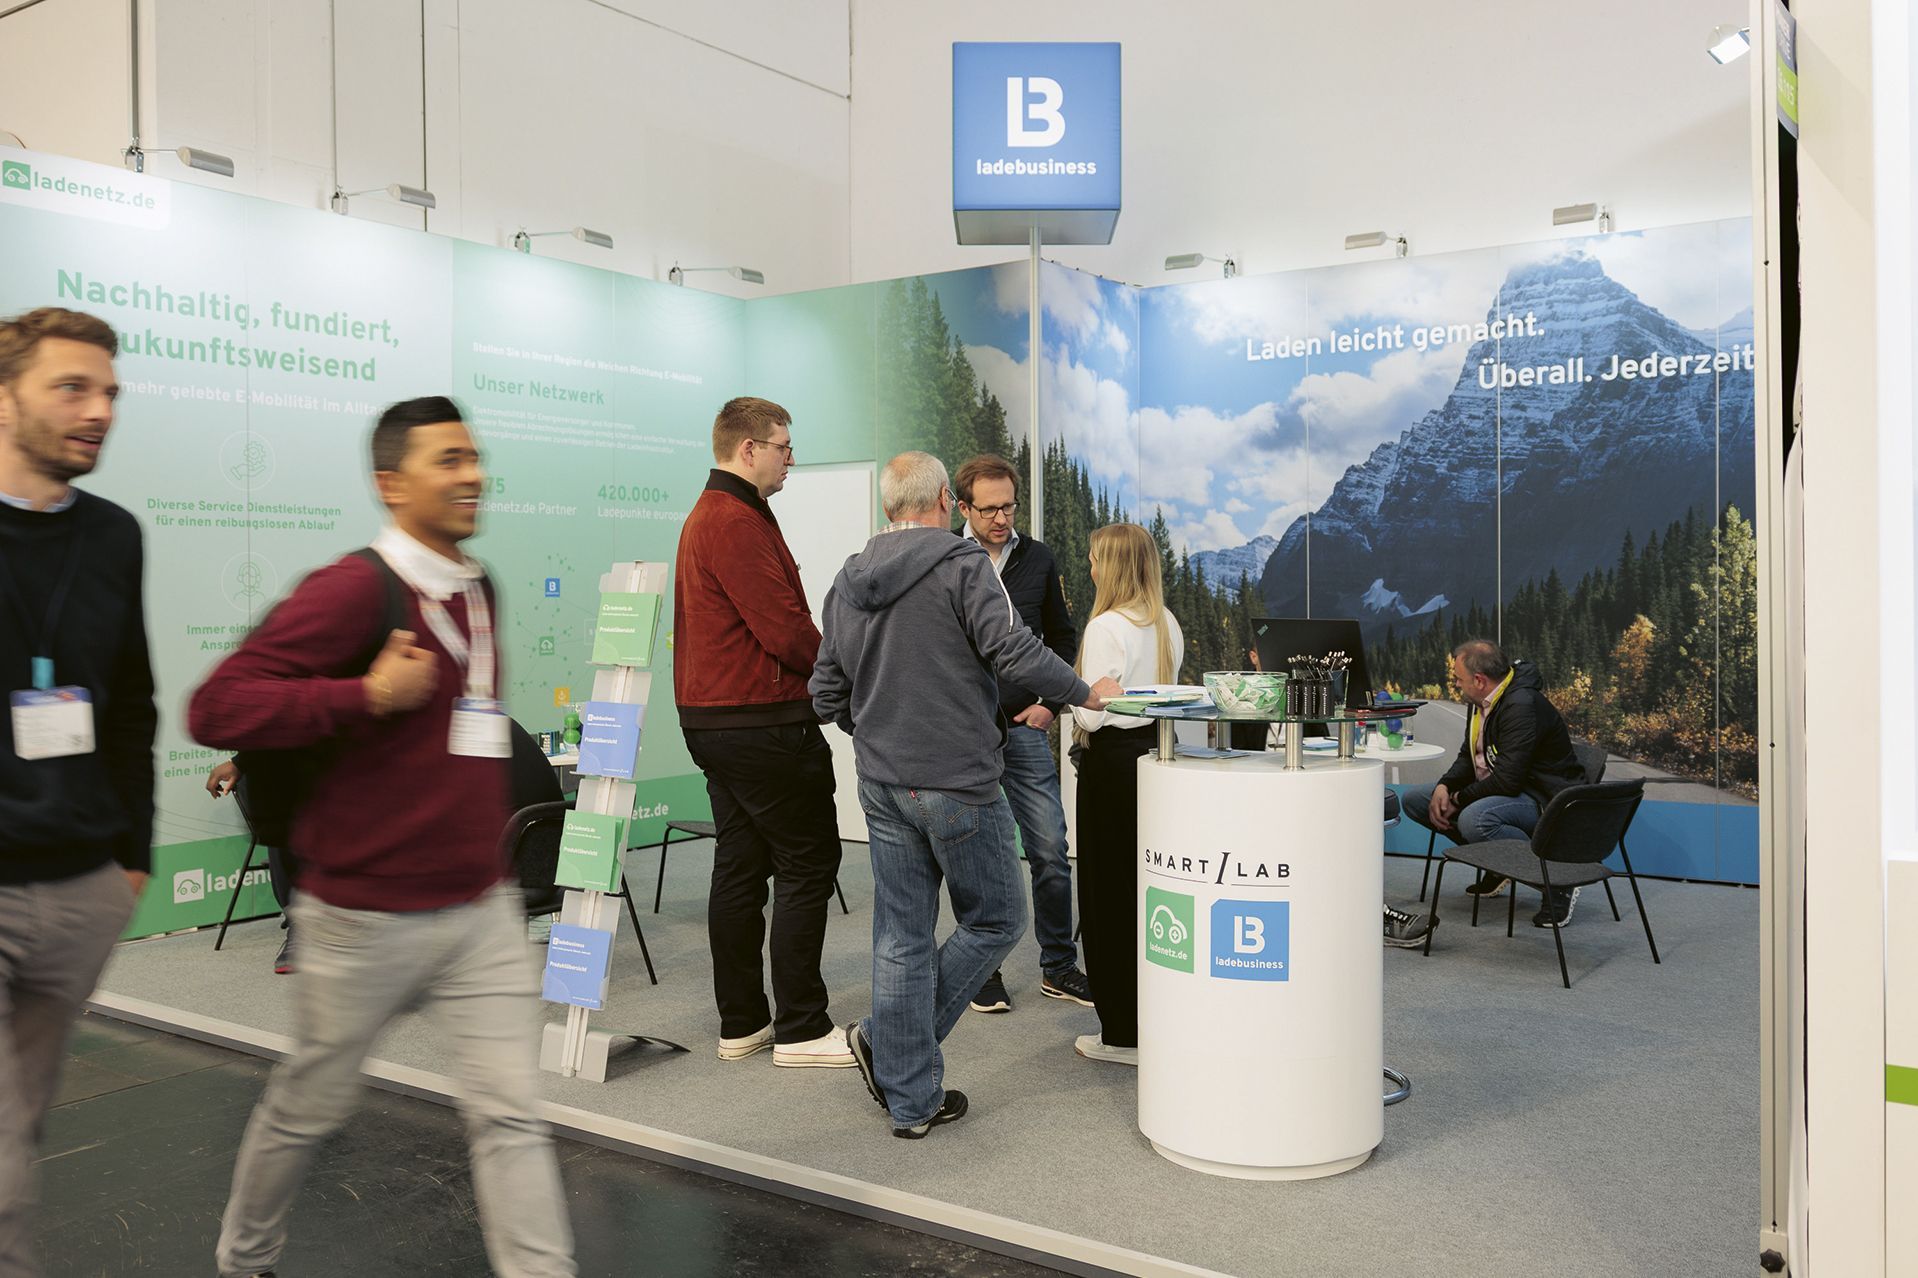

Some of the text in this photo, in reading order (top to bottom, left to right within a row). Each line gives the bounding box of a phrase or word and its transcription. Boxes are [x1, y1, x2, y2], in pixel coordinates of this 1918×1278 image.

[976, 159, 1098, 176] ladebusiness
[34, 171, 156, 209] ladenetz.de
[57, 269, 400, 348] Nachhaltig, fundiert,
[1246, 311, 1545, 362] Laden leicht gemacht.
[118, 328, 377, 382] ukunftsweisend
[1478, 343, 1755, 390] Überall. Jederzeit
[120, 380, 166, 396] mehr
[170, 384, 232, 401] gelebte
[235, 388, 320, 411] E-Mobilität
[322, 397, 341, 413] im
[473, 372, 605, 405] Unser Netzwerk
[598, 484, 670, 503] 420.000+
[147, 498, 342, 517] Diverse Service Dienstleistungen
[538, 502, 577, 517] Partner
[597, 505, 652, 521] Ladepunkte
[155, 515, 335, 531] für einen reibungslosen Ablauf
[186, 624, 226, 635] Immer
[169, 748, 213, 761] Breites
[164, 762, 217, 778] eine indi
[1149, 941, 1189, 961] ladenetz.de
[1215, 955, 1284, 969] ladebusiness
